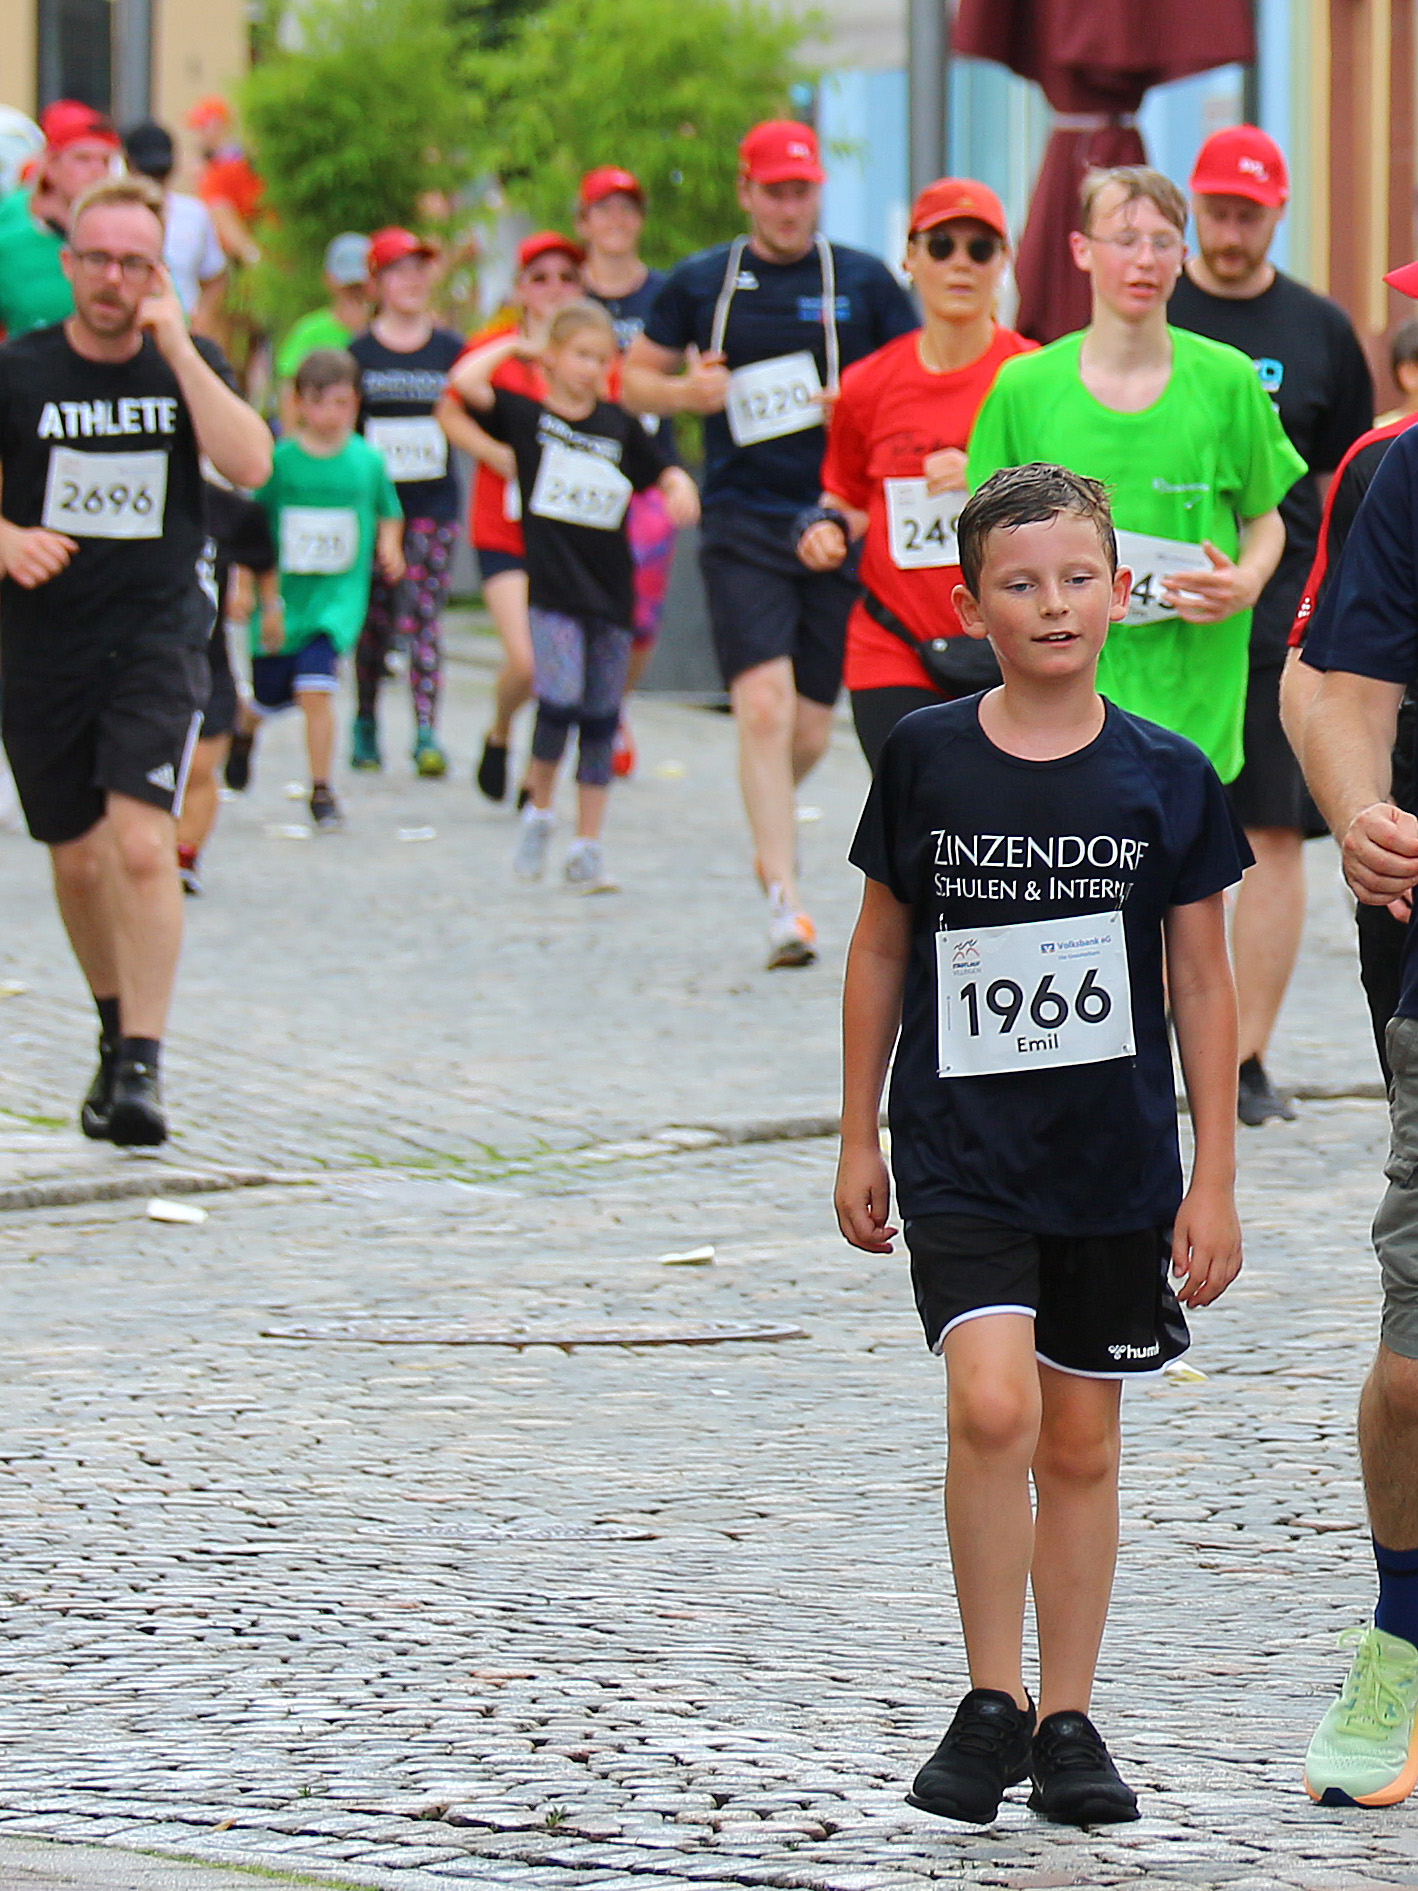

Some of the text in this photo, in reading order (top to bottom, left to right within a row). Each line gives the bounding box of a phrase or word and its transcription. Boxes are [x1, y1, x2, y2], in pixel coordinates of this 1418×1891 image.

[37, 396, 178, 439] ATHLETE
[60, 480, 152, 515] 2696
[930, 829, 1149, 870] ZINZENDORF
[1024, 880, 1041, 900] &
[1057, 935, 1112, 950] Volksbank eG
[961, 968, 1111, 1037] 1966
[1017, 1033, 1059, 1053] Emil
